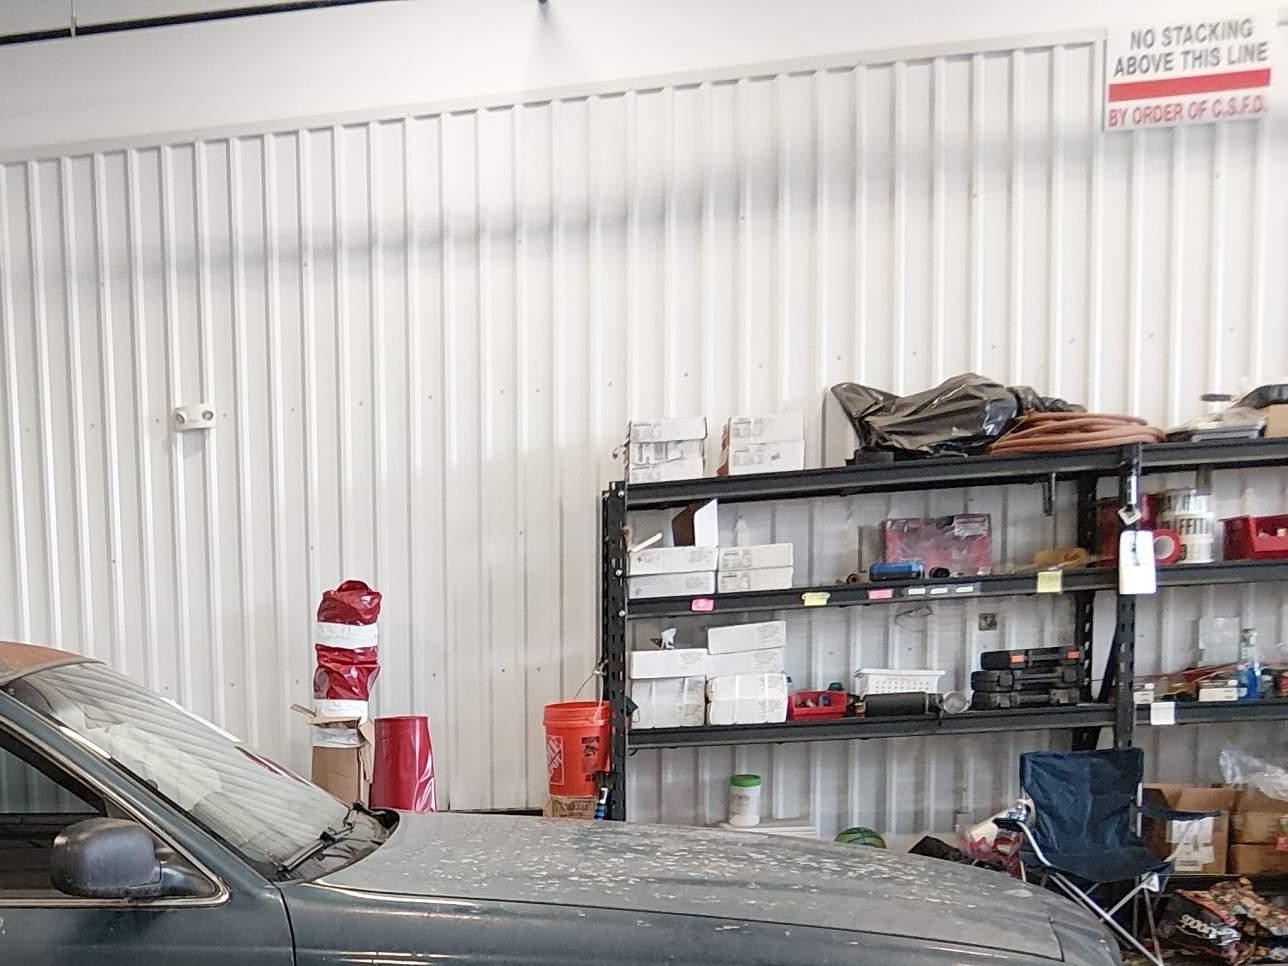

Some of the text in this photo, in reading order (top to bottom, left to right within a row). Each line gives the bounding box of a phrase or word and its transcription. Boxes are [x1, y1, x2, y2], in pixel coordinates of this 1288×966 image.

[1130, 18, 1253, 50] NO STACKING
[1113, 41, 1268, 77] ABOVE THIS LINE
[1108, 107, 1128, 128] BY
[1132, 103, 1183, 125] ORDER
[1188, 100, 1208, 120] OF
